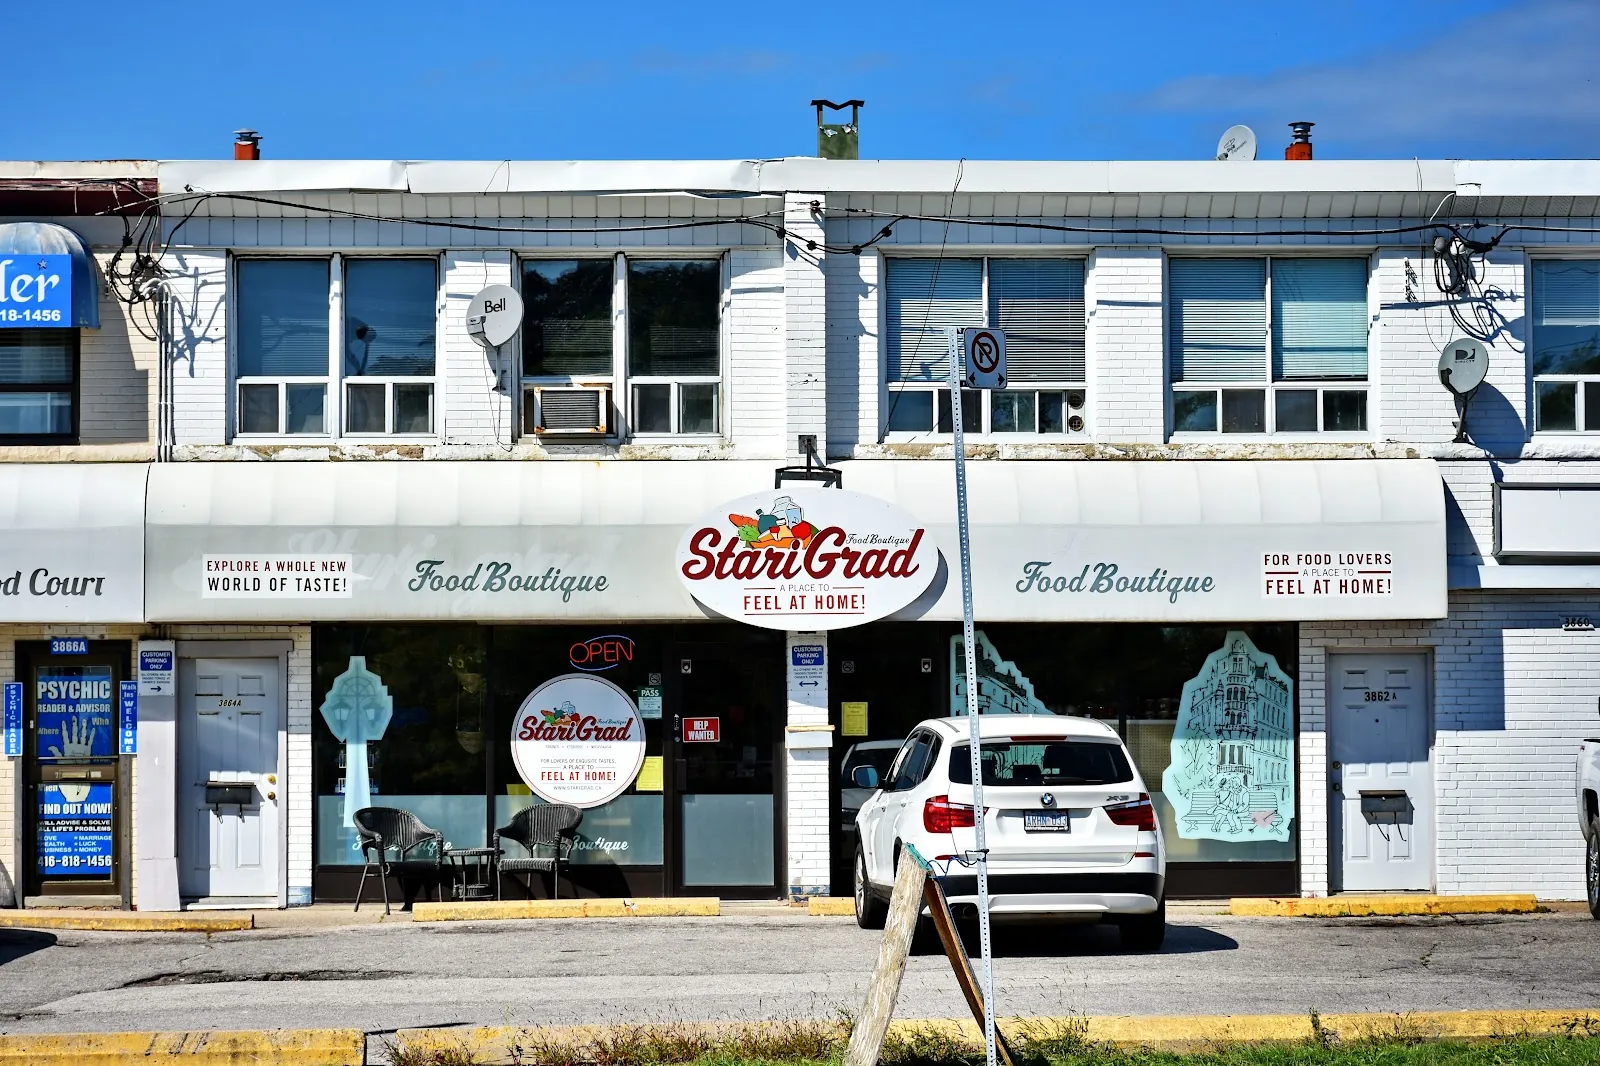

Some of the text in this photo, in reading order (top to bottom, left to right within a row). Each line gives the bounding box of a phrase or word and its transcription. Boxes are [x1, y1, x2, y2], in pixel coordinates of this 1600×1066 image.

[485, 298, 506, 313] Bell
[845, 534, 910, 547] Food Boutique
[1264, 554, 1392, 565] FOR FOOD LOVERS
[207, 561, 346, 571] EXPLORE A WHOLE NEW
[1343, 568, 1354, 576] TO
[0, 571, 22, 596] d
[208, 578, 346, 591] WORLD OF TASTE!
[408, 559, 609, 603] Food Boutique
[1015, 561, 1215, 603] Food Boutique
[1266, 579, 1391, 594] FEEL AT HOME!
[780, 584, 786, 592] A
[744, 595, 865, 610] FEEL AT HOME!
[1565, 618, 1589, 627] 3860
[53, 641, 86, 652] 3866A
[569, 641, 633, 662] OPEN
[37, 681, 111, 699] PSYCHIC
[1365, 692, 1390, 701] 3862
[38, 704, 111, 713] READER & ADVISOR
[92, 717, 109, 725] Who
[124, 701, 134, 752] WELCOME
[694, 721, 708, 730] HELP
[688, 731, 714, 740] WANTED
[541, 772, 616, 780] FEEL AT HOME!
[39, 804, 111, 814] FIND OUT NOW!
[38, 855, 111, 866] 416-818-1456
